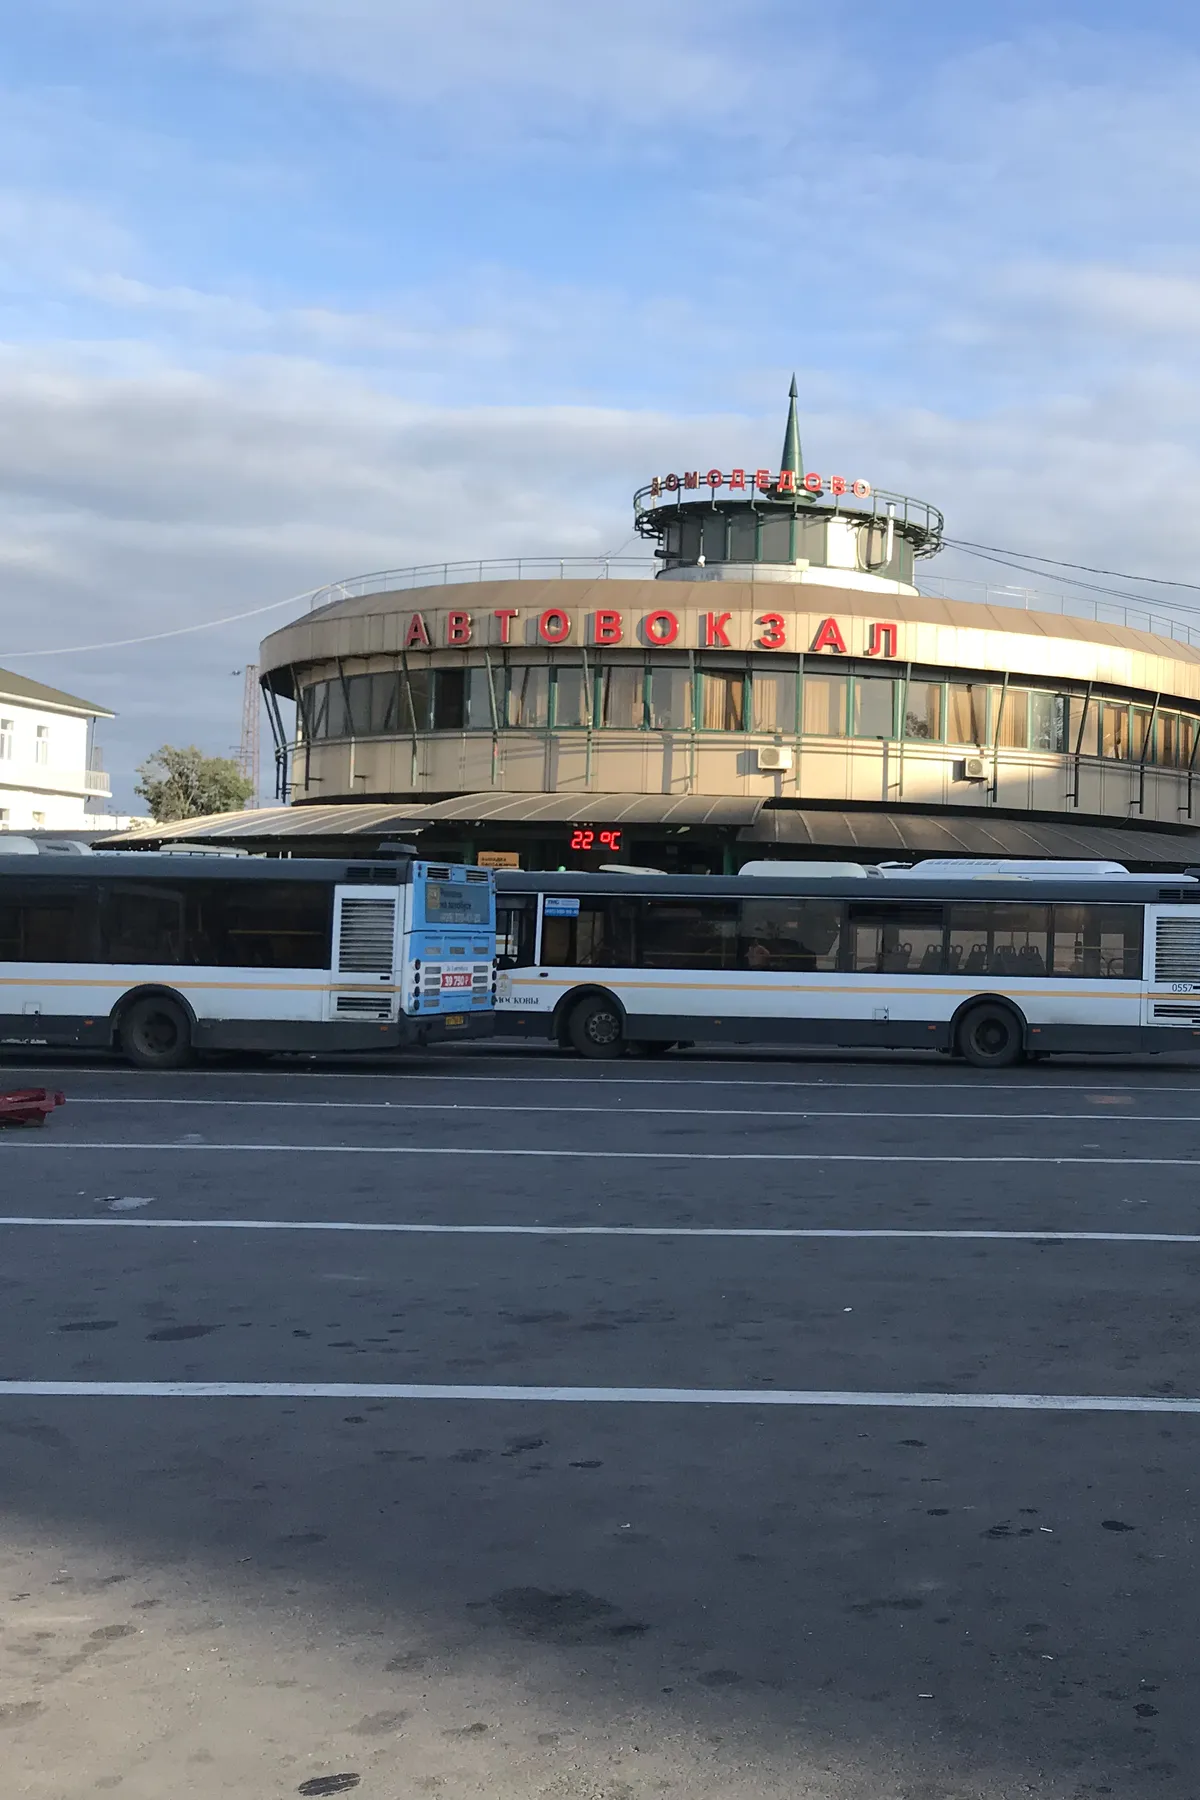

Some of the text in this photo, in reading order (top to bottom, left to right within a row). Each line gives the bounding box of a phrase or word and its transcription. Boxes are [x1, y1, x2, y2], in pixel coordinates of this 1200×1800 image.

[650, 469, 871, 499] ДОМОДЕДОВО
[403, 607, 899, 658] АВТОВОКЗАЛ
[571, 831, 594, 849] 22
[1172, 984, 1193, 992] 0557
